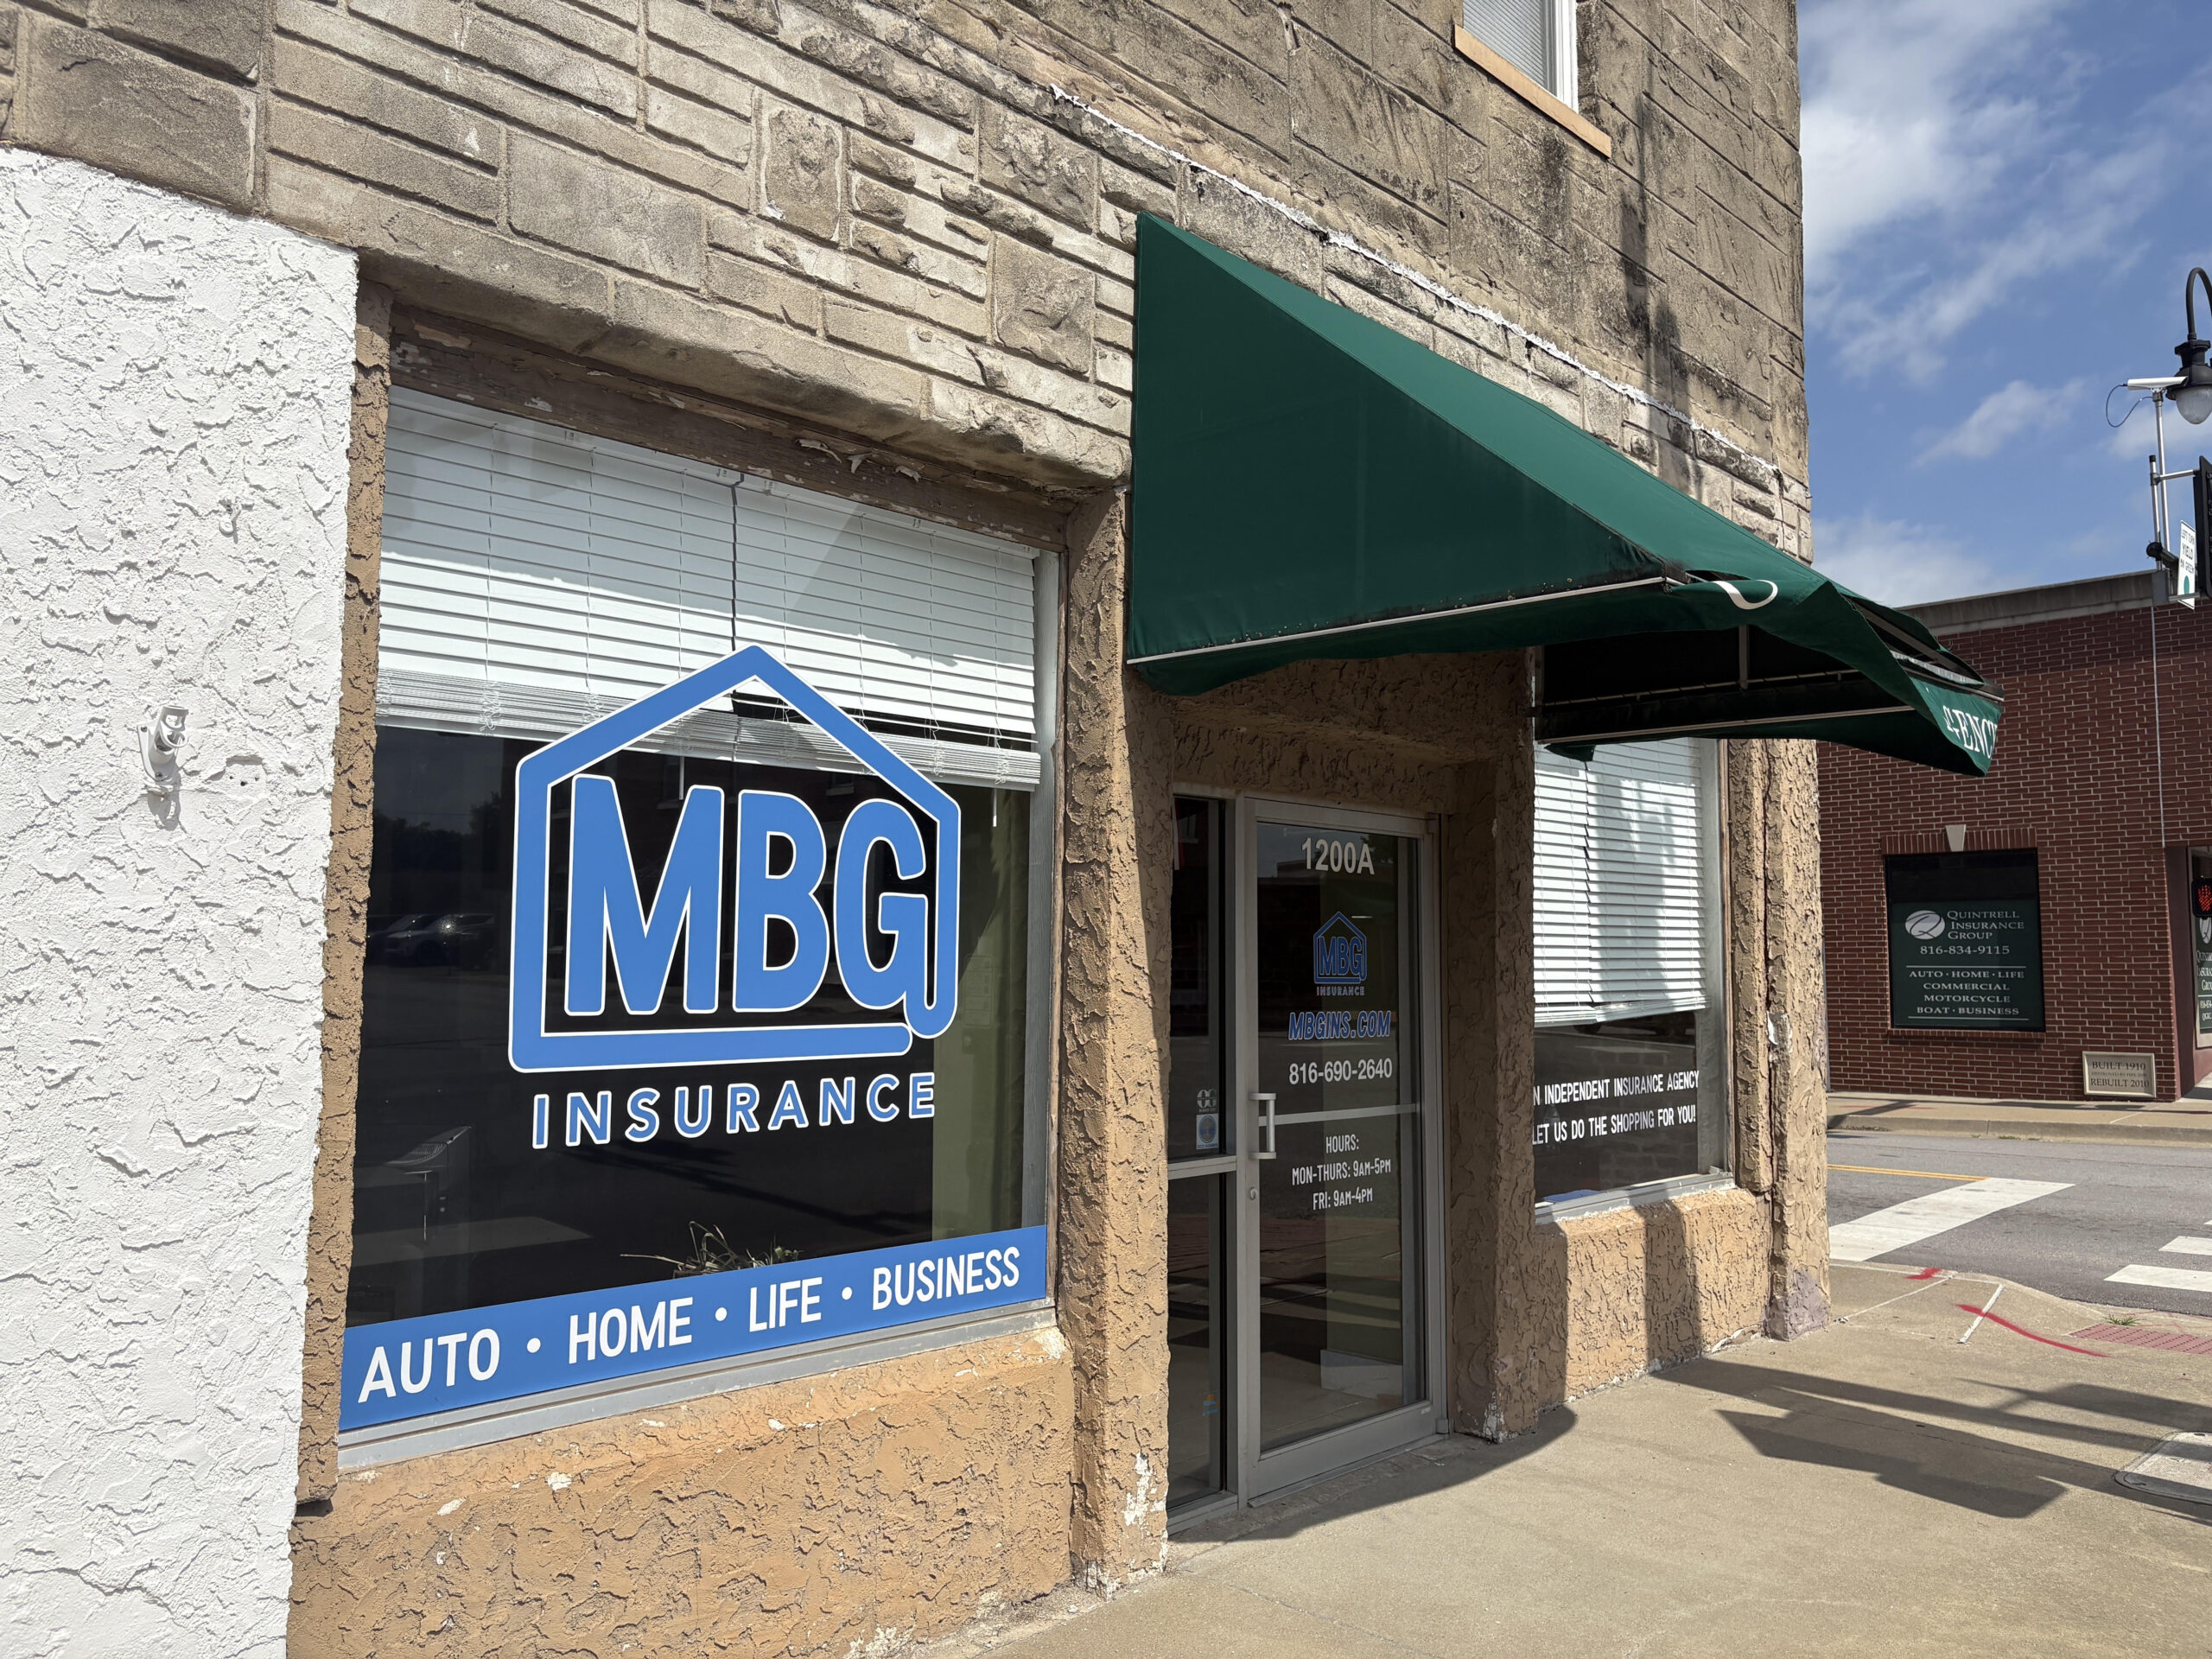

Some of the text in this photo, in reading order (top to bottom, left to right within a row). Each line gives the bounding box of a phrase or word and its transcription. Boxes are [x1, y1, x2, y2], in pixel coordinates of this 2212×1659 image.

[2182, 543, 2193, 560] YIELD
[1301, 837, 1375, 874] 1200A
[564, 774, 927, 1015] MBG
[1947, 910, 2019, 920] QUINTRELL
[1948, 931, 1993, 940] GROUP
[1951, 921, 2024, 930] INSURANCE
[1319, 937, 1363, 976] MBG
[1920, 945, 2010, 955] 816-834-9115
[1316, 986, 1365, 996] INSURANCE
[1923, 982, 2010, 991] COMMERCIAL
[1923, 995, 2011, 1003] MOTORCYCLE
[1916, 1006, 2019, 1015] BOAT BUSINESS
[1288, 1010, 1391, 1040] MBGINS.COM
[1289, 1058, 1392, 1085] 816-690-2640
[2092, 1061, 2146, 1071] BUILT 1910
[1544, 1079, 1610, 1105] INDEPENDENT
[1614, 1073, 1663, 1096] INSURANCE
[1667, 1070, 1700, 1091] AGENCY
[2090, 1077, 2150, 1088] REBUILT 2010
[532, 1072, 935, 1149] INSURANCE
[1554, 1121, 1567, 1142] US
[1572, 1118, 1585, 1140] DO
[1588, 1116, 1607, 1137] THE
[1611, 1110, 1654, 1134] SHOPPING
[1657, 1107, 1675, 1128] FOR
[1677, 1104, 1696, 1124] YOU!
[1325, 1134, 1359, 1154] HOURS:
[1292, 1158, 1391, 1185] MON-THURS: 9AM-5PM
[1313, 1187, 1373, 1210] FRI: 9AM-4PM
[357, 1246, 1020, 1403] AUTO HOME LIFE BUSINESS
